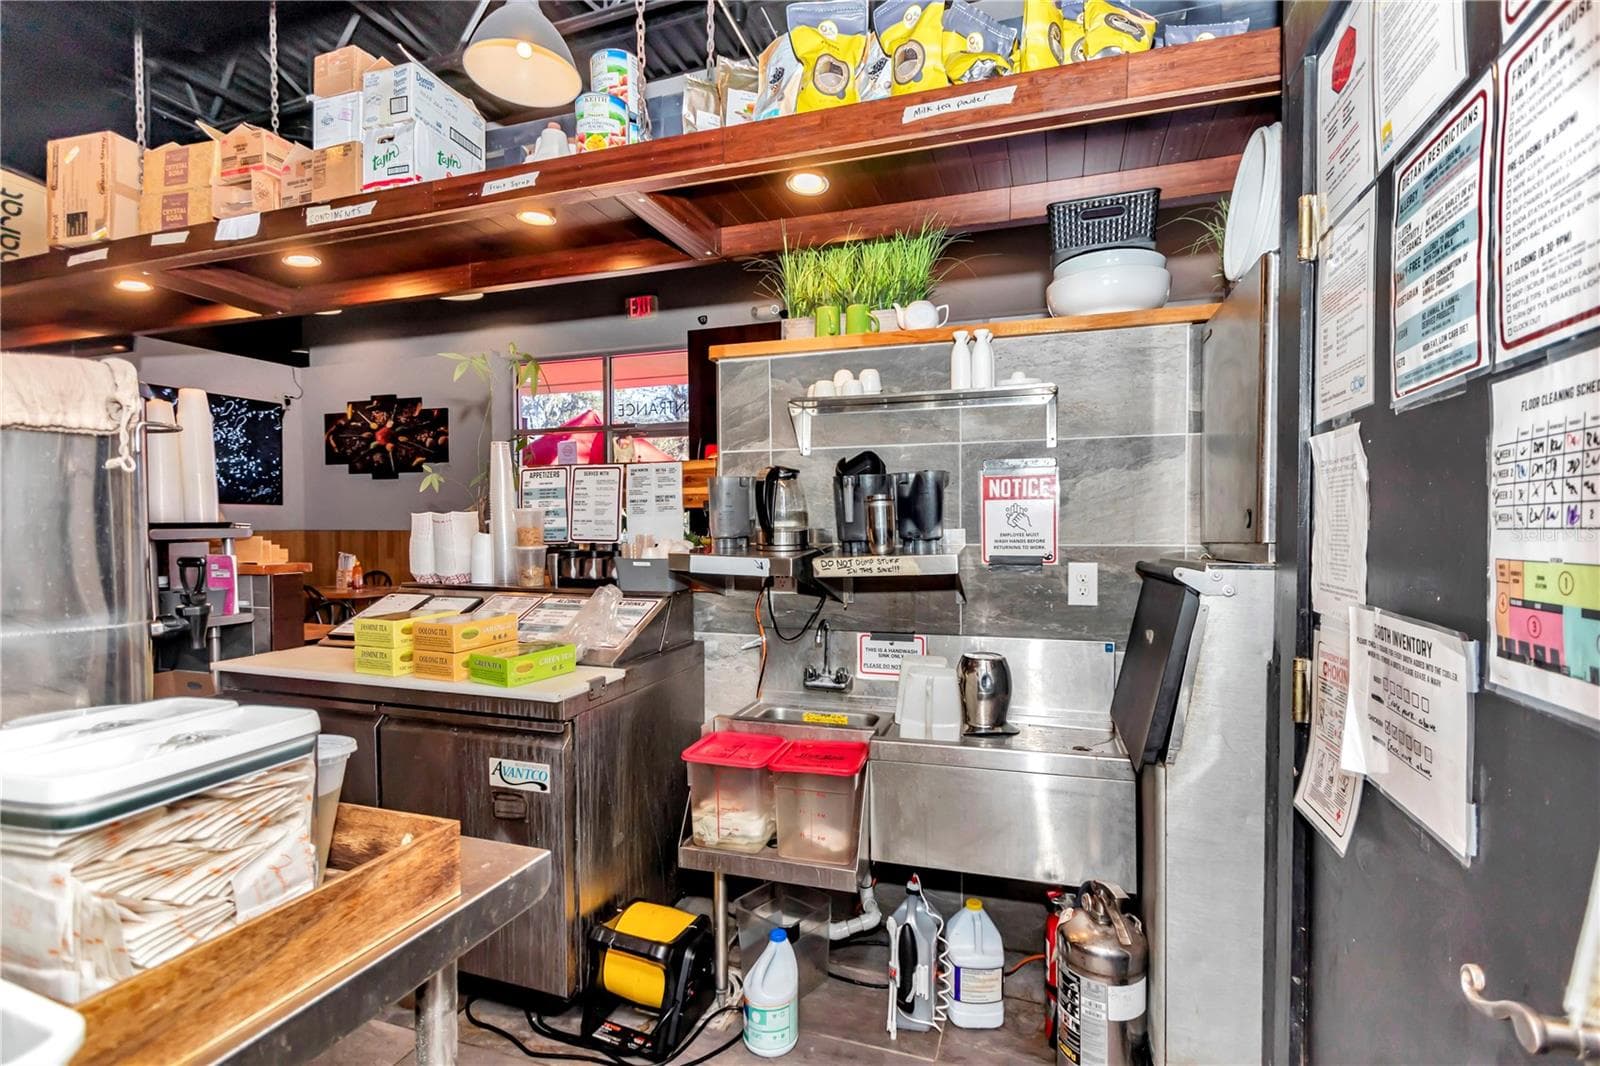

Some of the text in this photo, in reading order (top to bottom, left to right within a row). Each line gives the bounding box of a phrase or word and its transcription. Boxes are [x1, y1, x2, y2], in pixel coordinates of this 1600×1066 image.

[1512, 0, 1592, 84] FRONT OF HOUSE
[1402, 106, 1478, 191] DIETARY RESTRICTIONS
[630, 297, 652, 317] EXIT
[1521, 397, 1540, 411] FLOOR
[1541, 386, 1574, 407] CLEANING
[529, 470, 560, 479] APPETIZERS
[989, 478, 1051, 498] NOTICE
[821, 560, 834, 568] DO
[836, 559, 853, 567] NOT
[418, 627, 438, 635] OOLONG
[1392, 631, 1432, 658] INVENTORY
[419, 655, 439, 664] OOLONG
[474, 659, 502, 669] GREEN TEA
[1322, 660, 1349, 685] CHOKIN
[491, 761, 548, 785] AVANTCO
